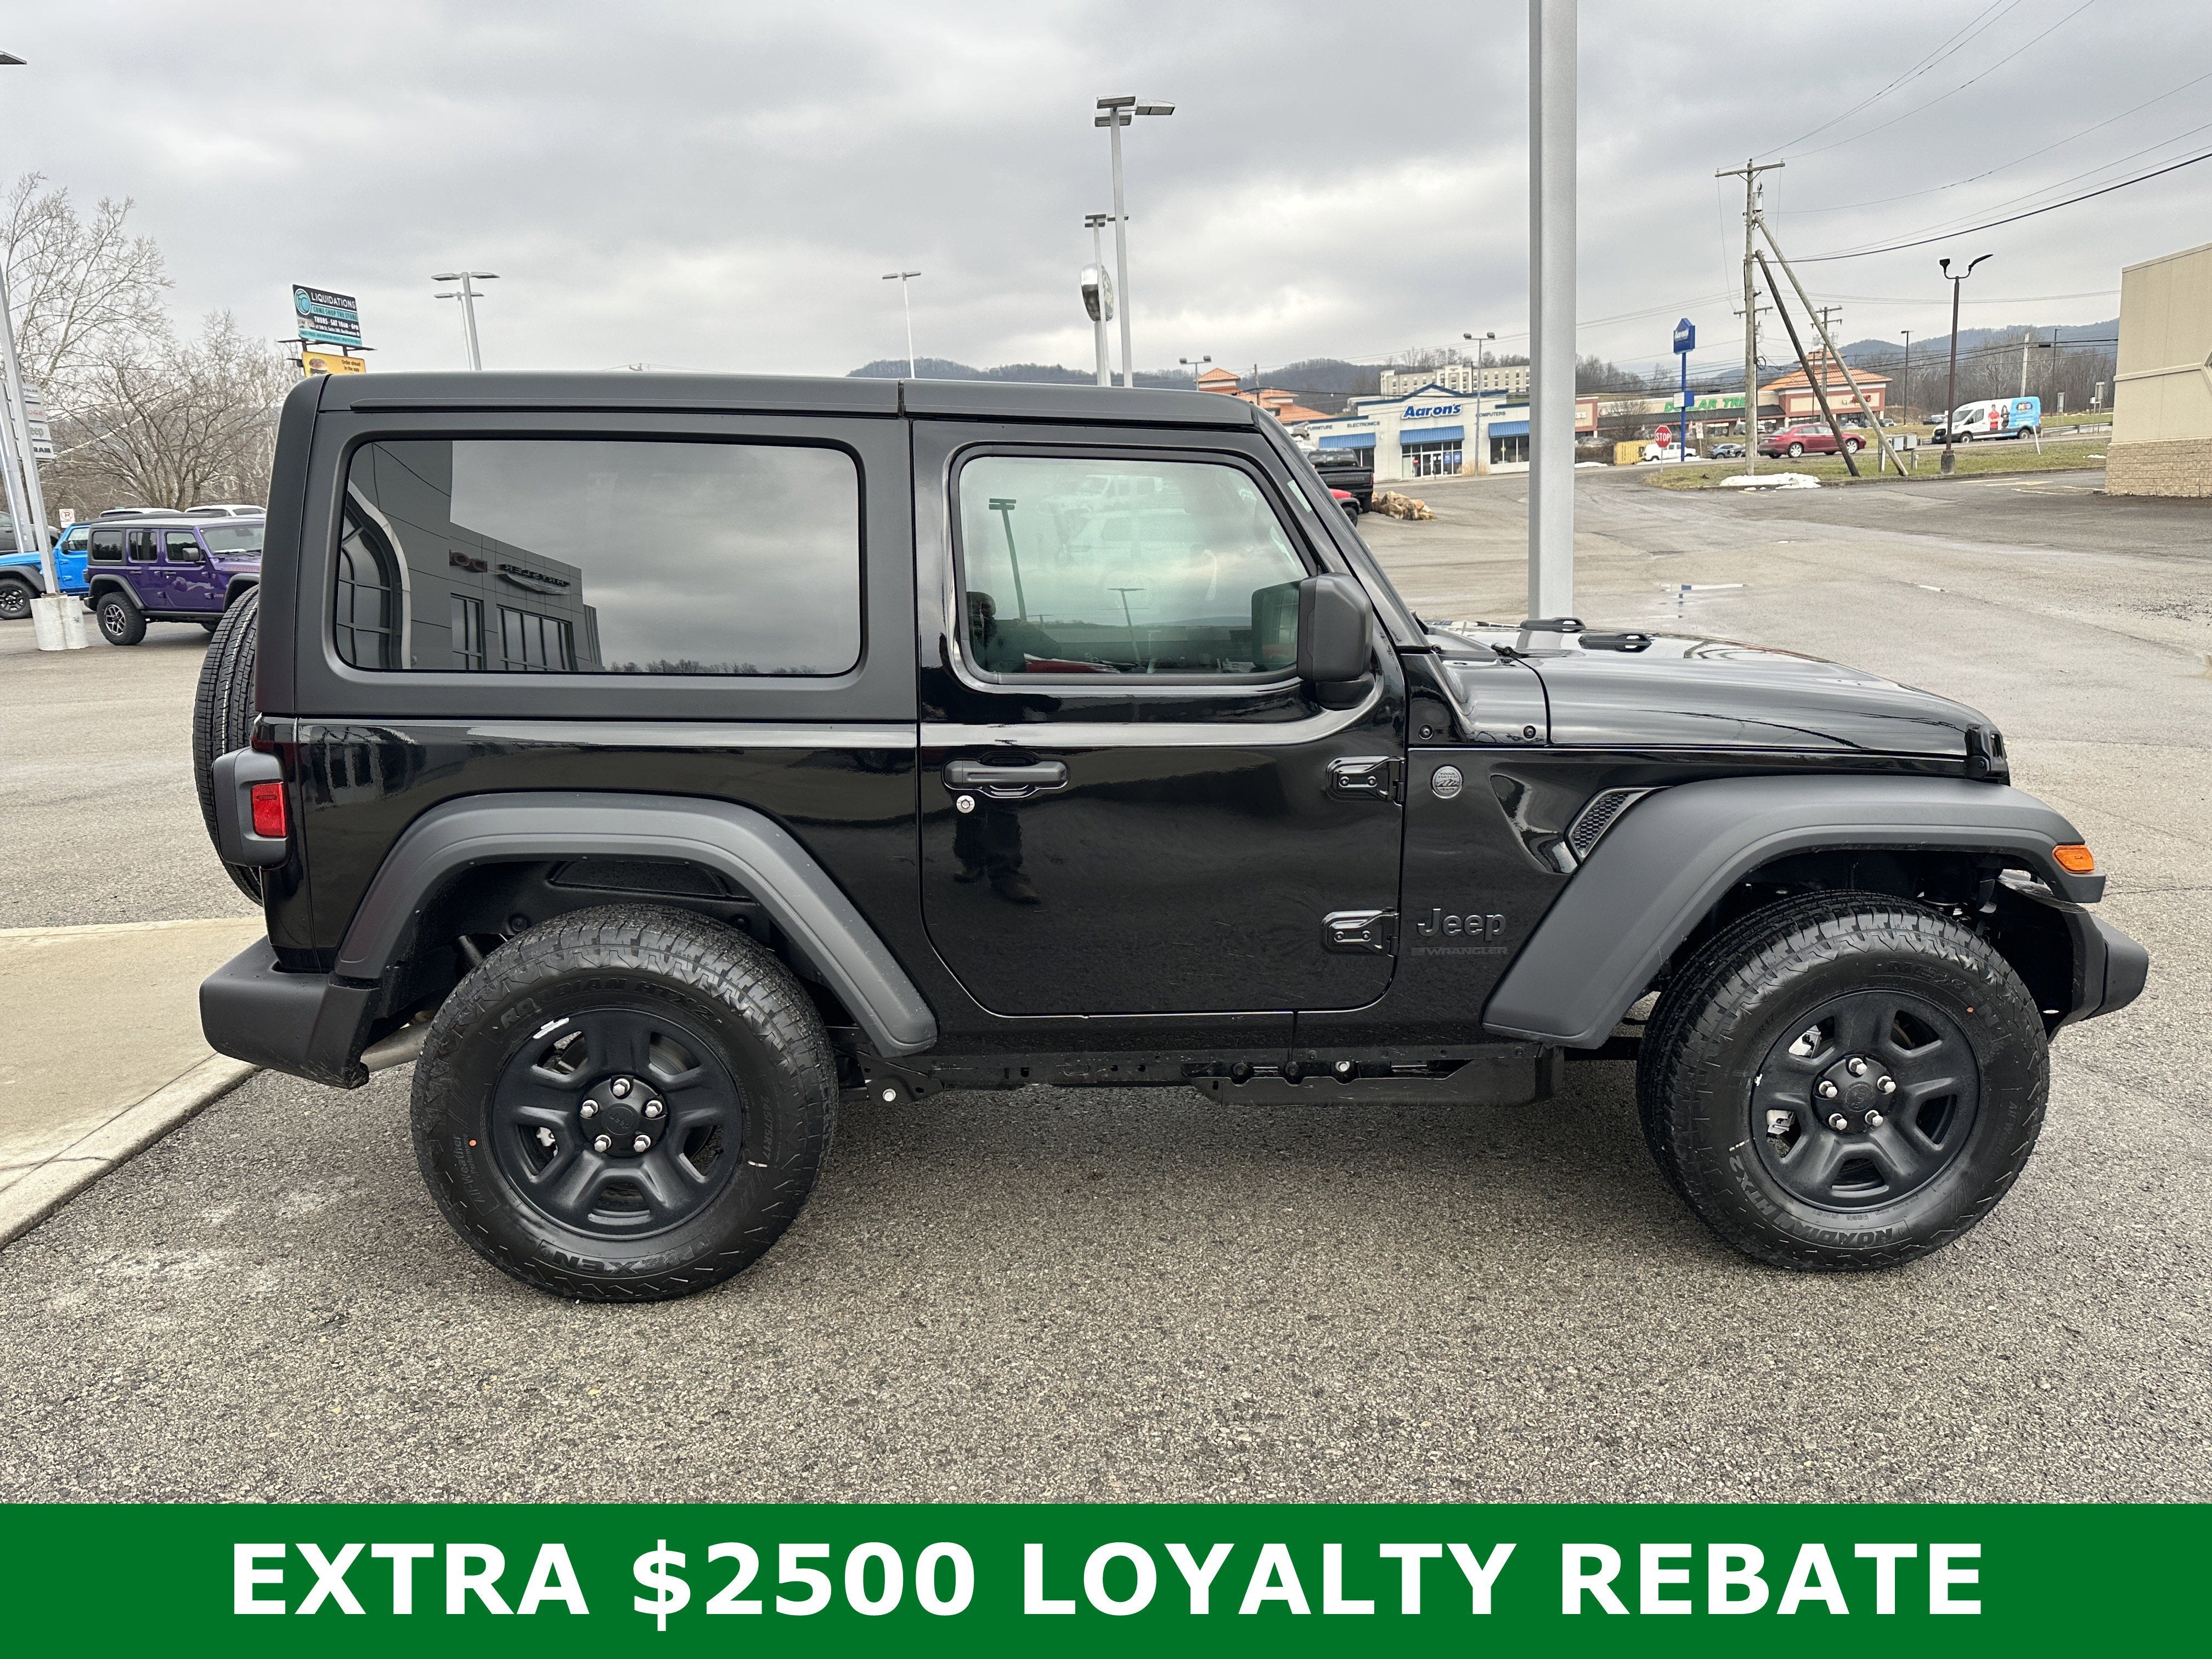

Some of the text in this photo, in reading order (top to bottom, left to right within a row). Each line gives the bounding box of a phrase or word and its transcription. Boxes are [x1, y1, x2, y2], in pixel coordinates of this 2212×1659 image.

[311, 291, 356, 309] LIQUIDATIONS
[313, 306, 325, 314] COME
[325, 308, 336, 316] SHOP
[313, 315, 328, 325] THURS
[1723, 396, 1746, 408] TRE
[1402, 403, 1462, 419] Aaron's
[30, 427, 44, 438] eep
[1656, 432, 1671, 442] STOP
[1417, 907, 1506, 942] Jeep
[1426, 946, 1508, 955] WRANGLER
[760, 1095, 774, 1161] 245/75R17
[453, 1133, 486, 1203] All-Weather
[1729, 1154, 1893, 1246] ROADIAN HTX2
